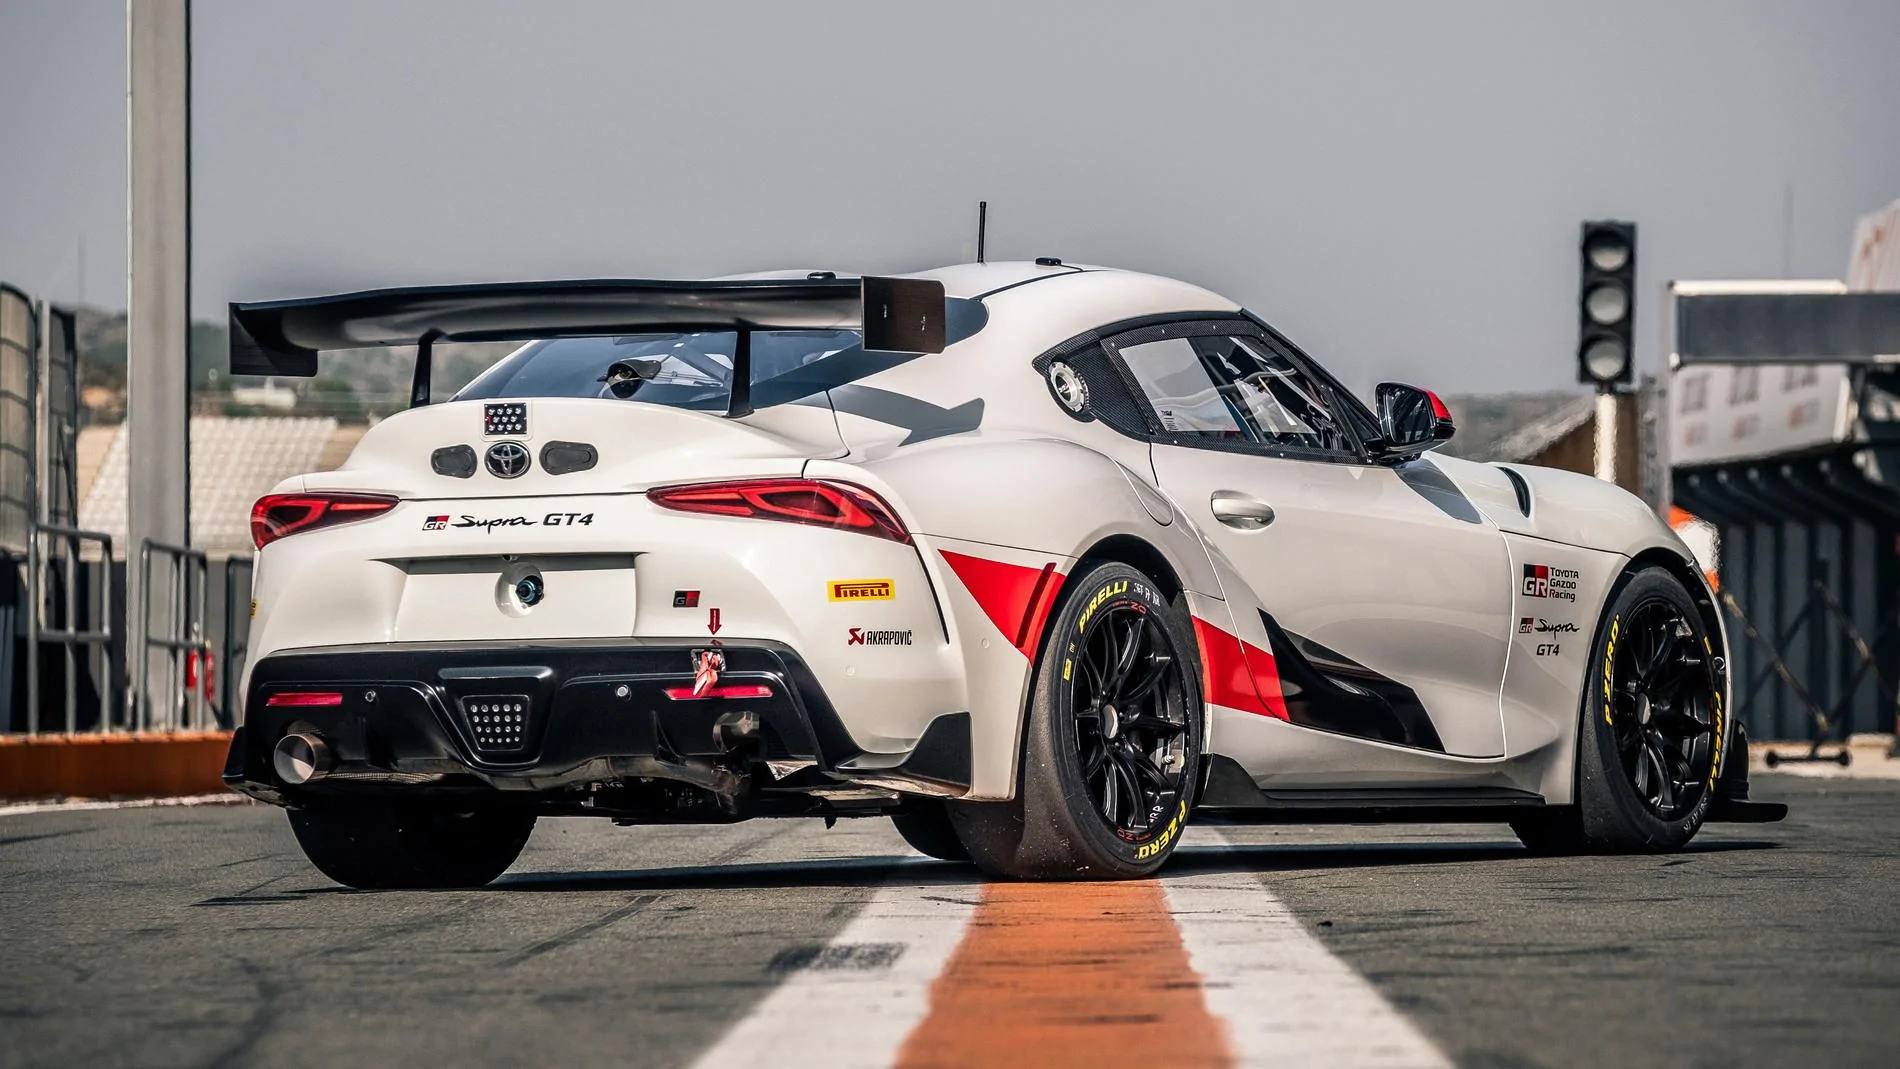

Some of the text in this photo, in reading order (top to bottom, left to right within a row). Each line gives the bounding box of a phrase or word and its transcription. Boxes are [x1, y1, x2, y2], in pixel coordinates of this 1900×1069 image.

[451, 515, 537, 534] Supra
[543, 513, 594, 526] GT4
[1550, 567, 1579, 579] TOYOTA
[834, 582, 890, 598] PIRELLI
[1523, 576, 1547, 596] GR
[1550, 578, 1577, 590] GAZOO
[1549, 589, 1576, 603] Racing
[1080, 580, 1128, 634] PIRELLI
[866, 629, 912, 646] AKRAPOVIČ
[1534, 619, 1580, 641] Supra
[1537, 643, 1560, 656] GT4
[1604, 623, 1619, 726] P ZERO
[1178, 800, 1186, 823] P
[1138, 817, 1178, 859] ZERO
